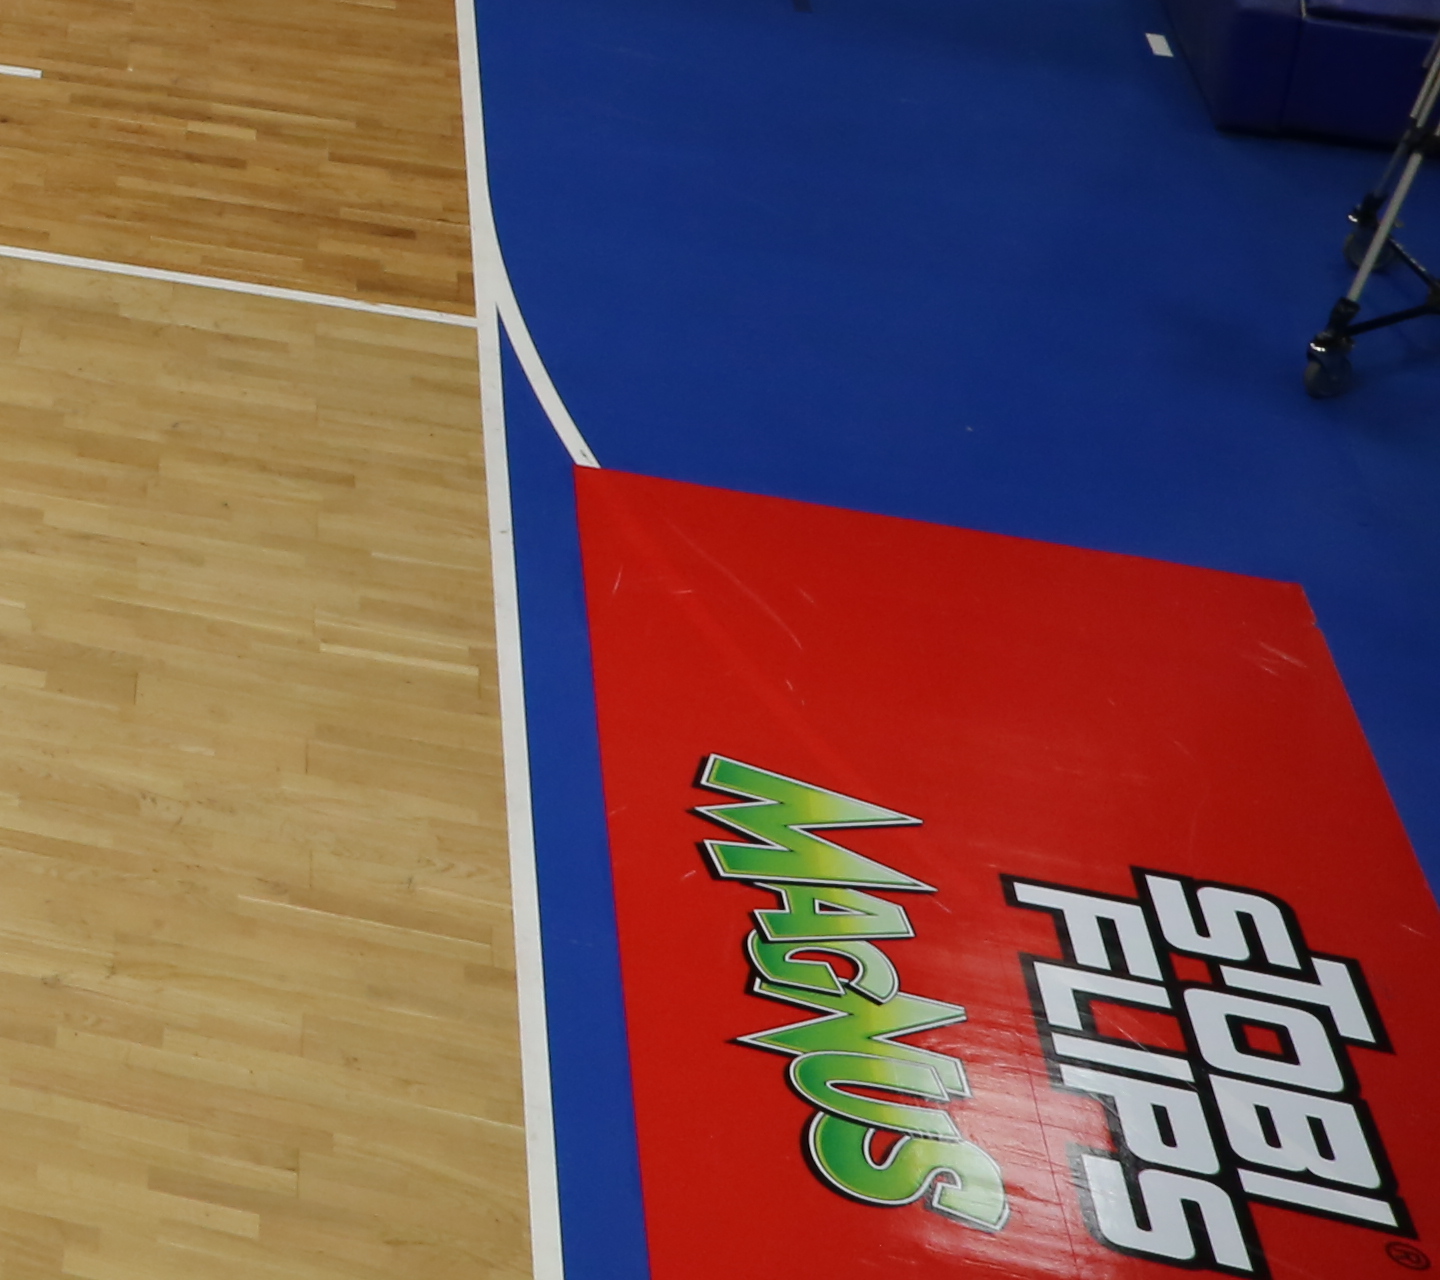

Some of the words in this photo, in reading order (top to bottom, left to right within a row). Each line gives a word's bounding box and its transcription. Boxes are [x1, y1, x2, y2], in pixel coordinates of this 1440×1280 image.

[690, 751, 1012, 1233] MAGNUS
[999, 872, 1272, 1280] FLIPS
[1130, 866, 1419, 1240] STOBI
